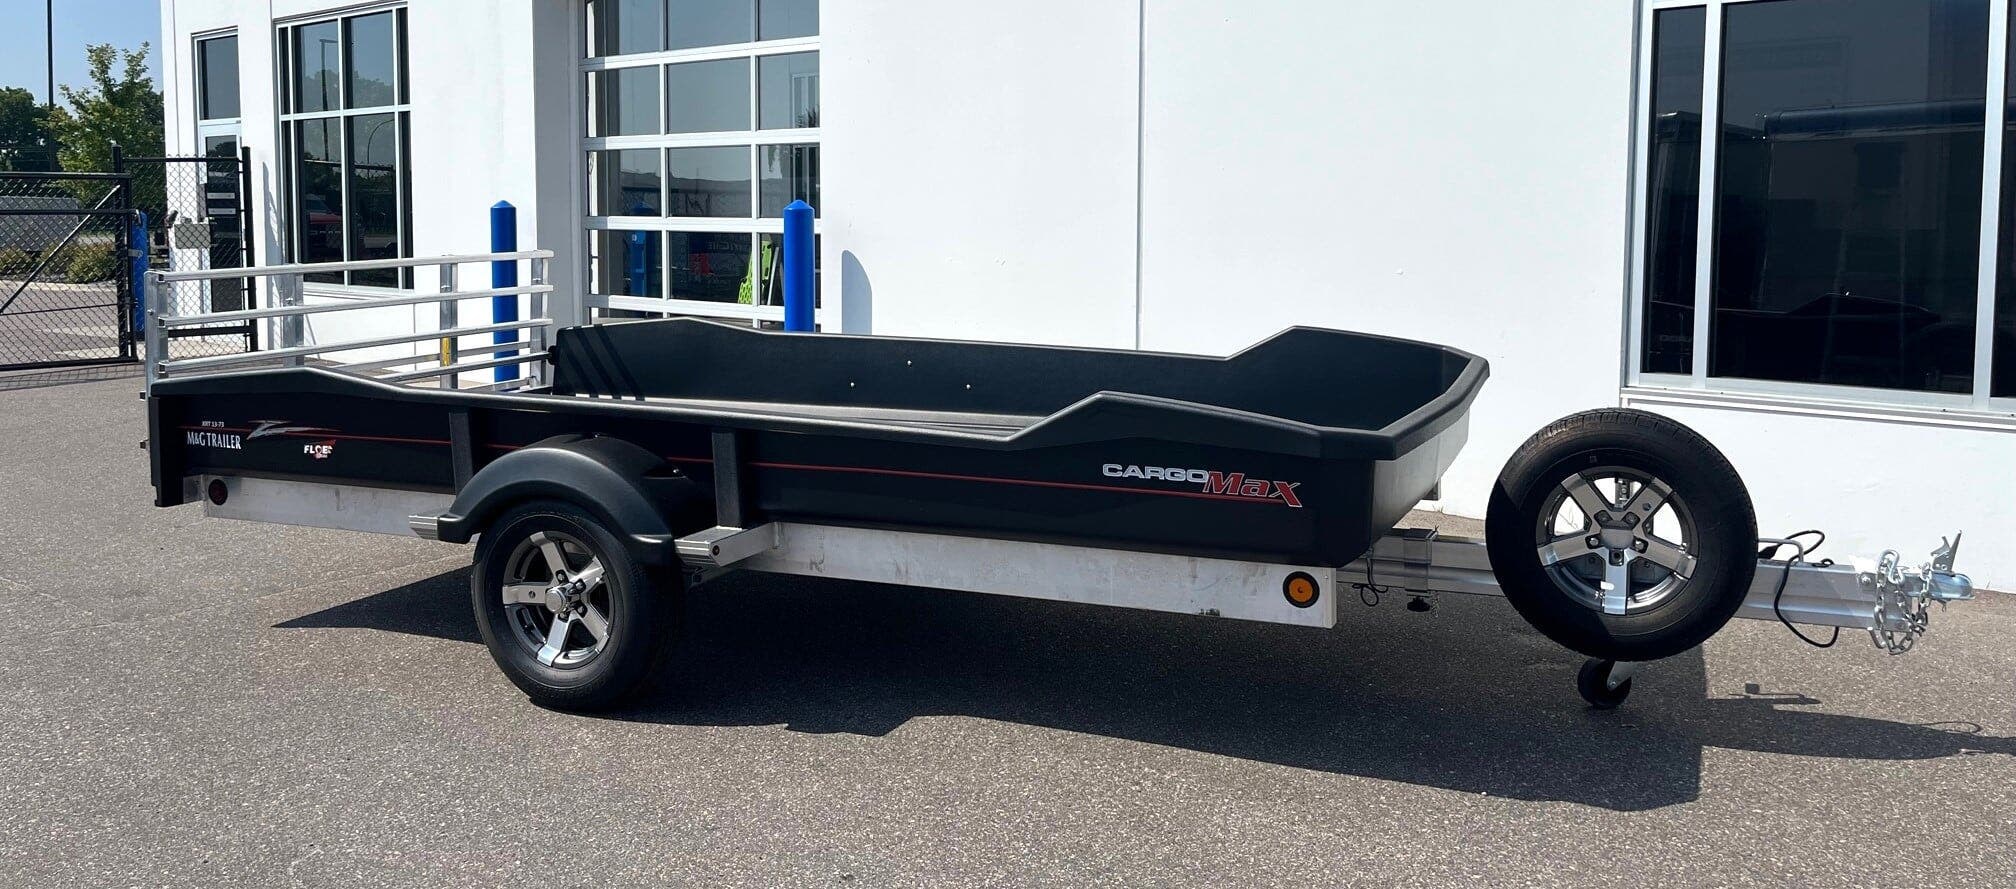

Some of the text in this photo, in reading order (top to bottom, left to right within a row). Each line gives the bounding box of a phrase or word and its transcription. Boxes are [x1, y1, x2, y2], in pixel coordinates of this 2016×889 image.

[187, 431, 242, 449] M&G TRAILER
[303, 444, 328, 454] FLOE
